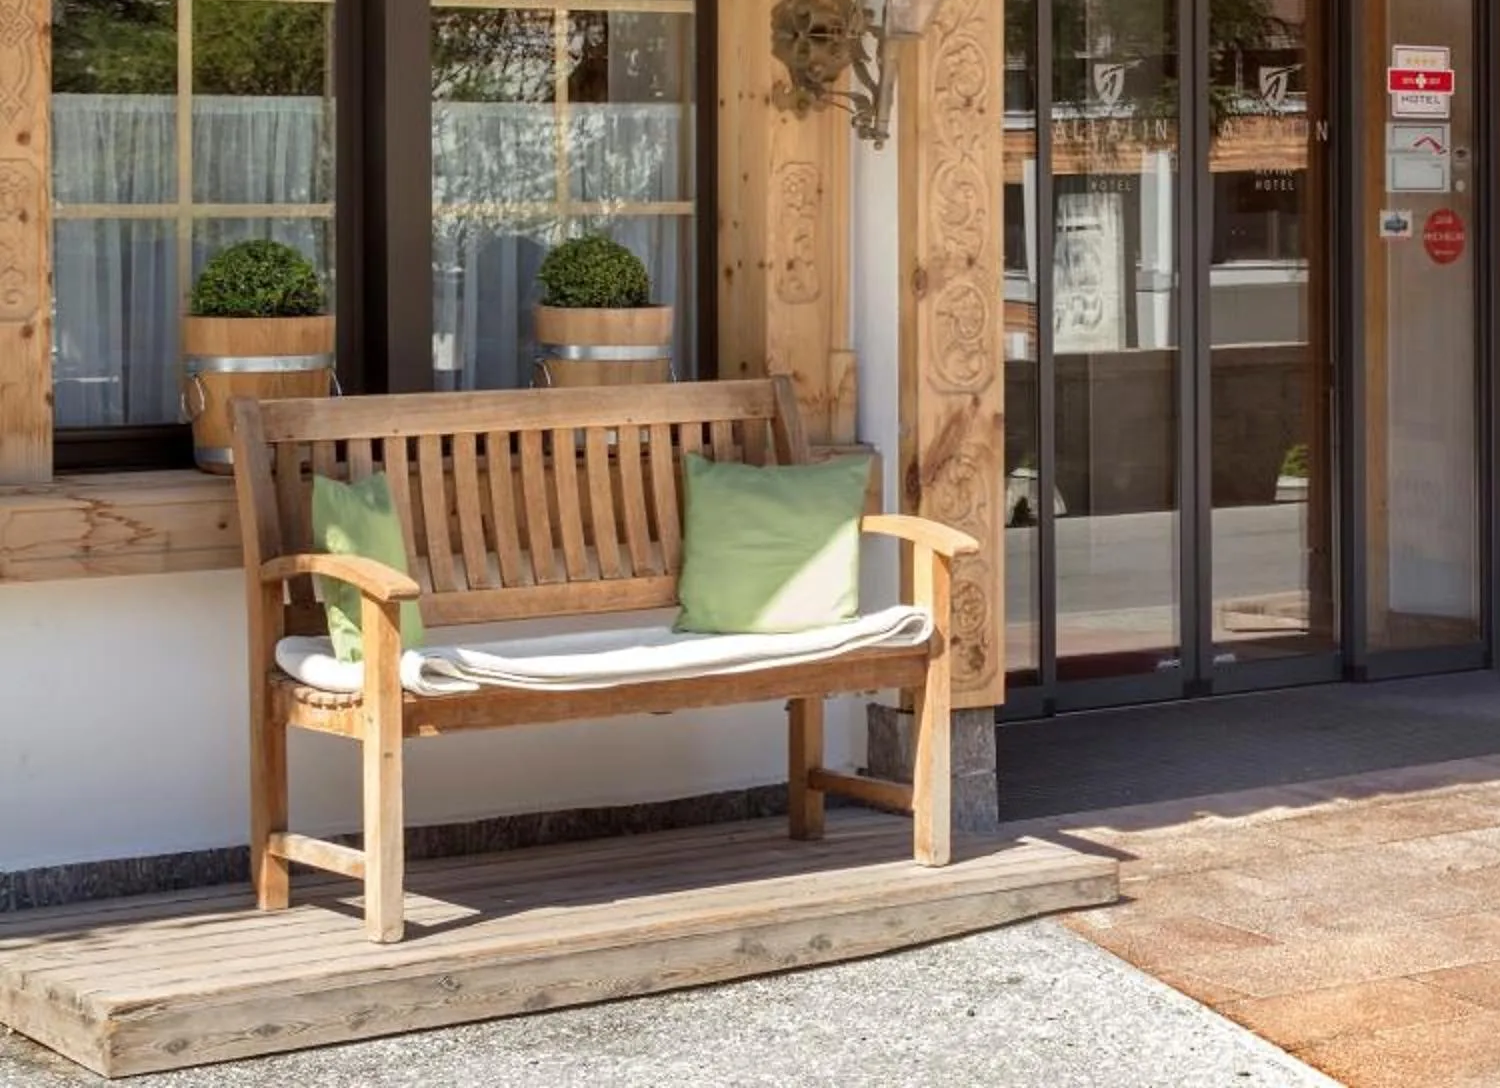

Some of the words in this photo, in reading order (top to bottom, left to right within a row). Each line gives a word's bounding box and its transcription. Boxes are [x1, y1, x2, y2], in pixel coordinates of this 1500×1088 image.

[1401, 95, 1441, 106] HOTEL
[1091, 179, 1133, 192] HOTEL
[1255, 179, 1296, 192] HOTEL
